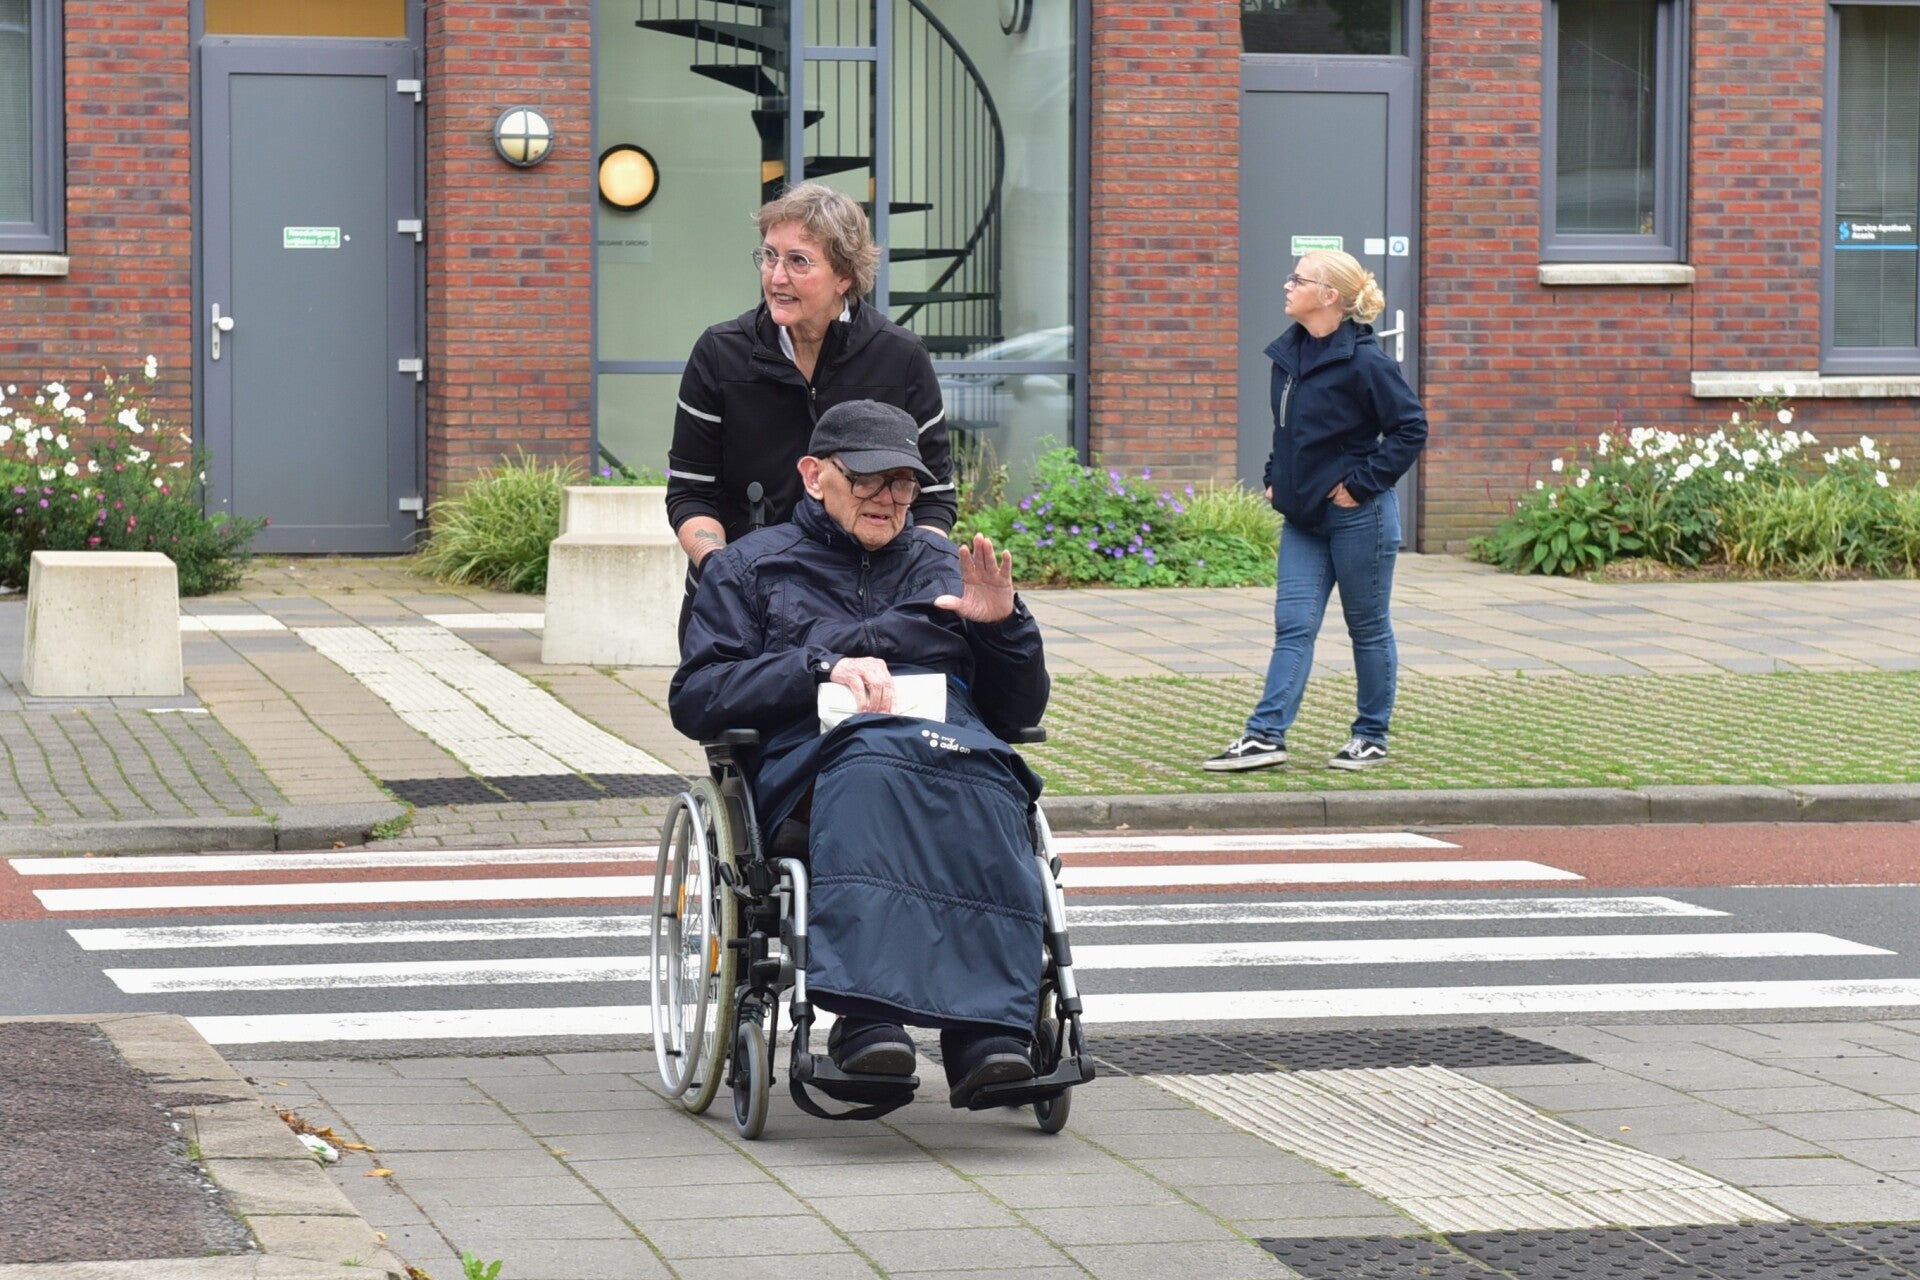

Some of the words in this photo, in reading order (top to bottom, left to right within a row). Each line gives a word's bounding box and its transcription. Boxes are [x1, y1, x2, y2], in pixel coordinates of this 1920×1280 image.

[941, 736, 957, 745] my
[940, 742, 959, 751] add
[959, 746, 971, 755] on
